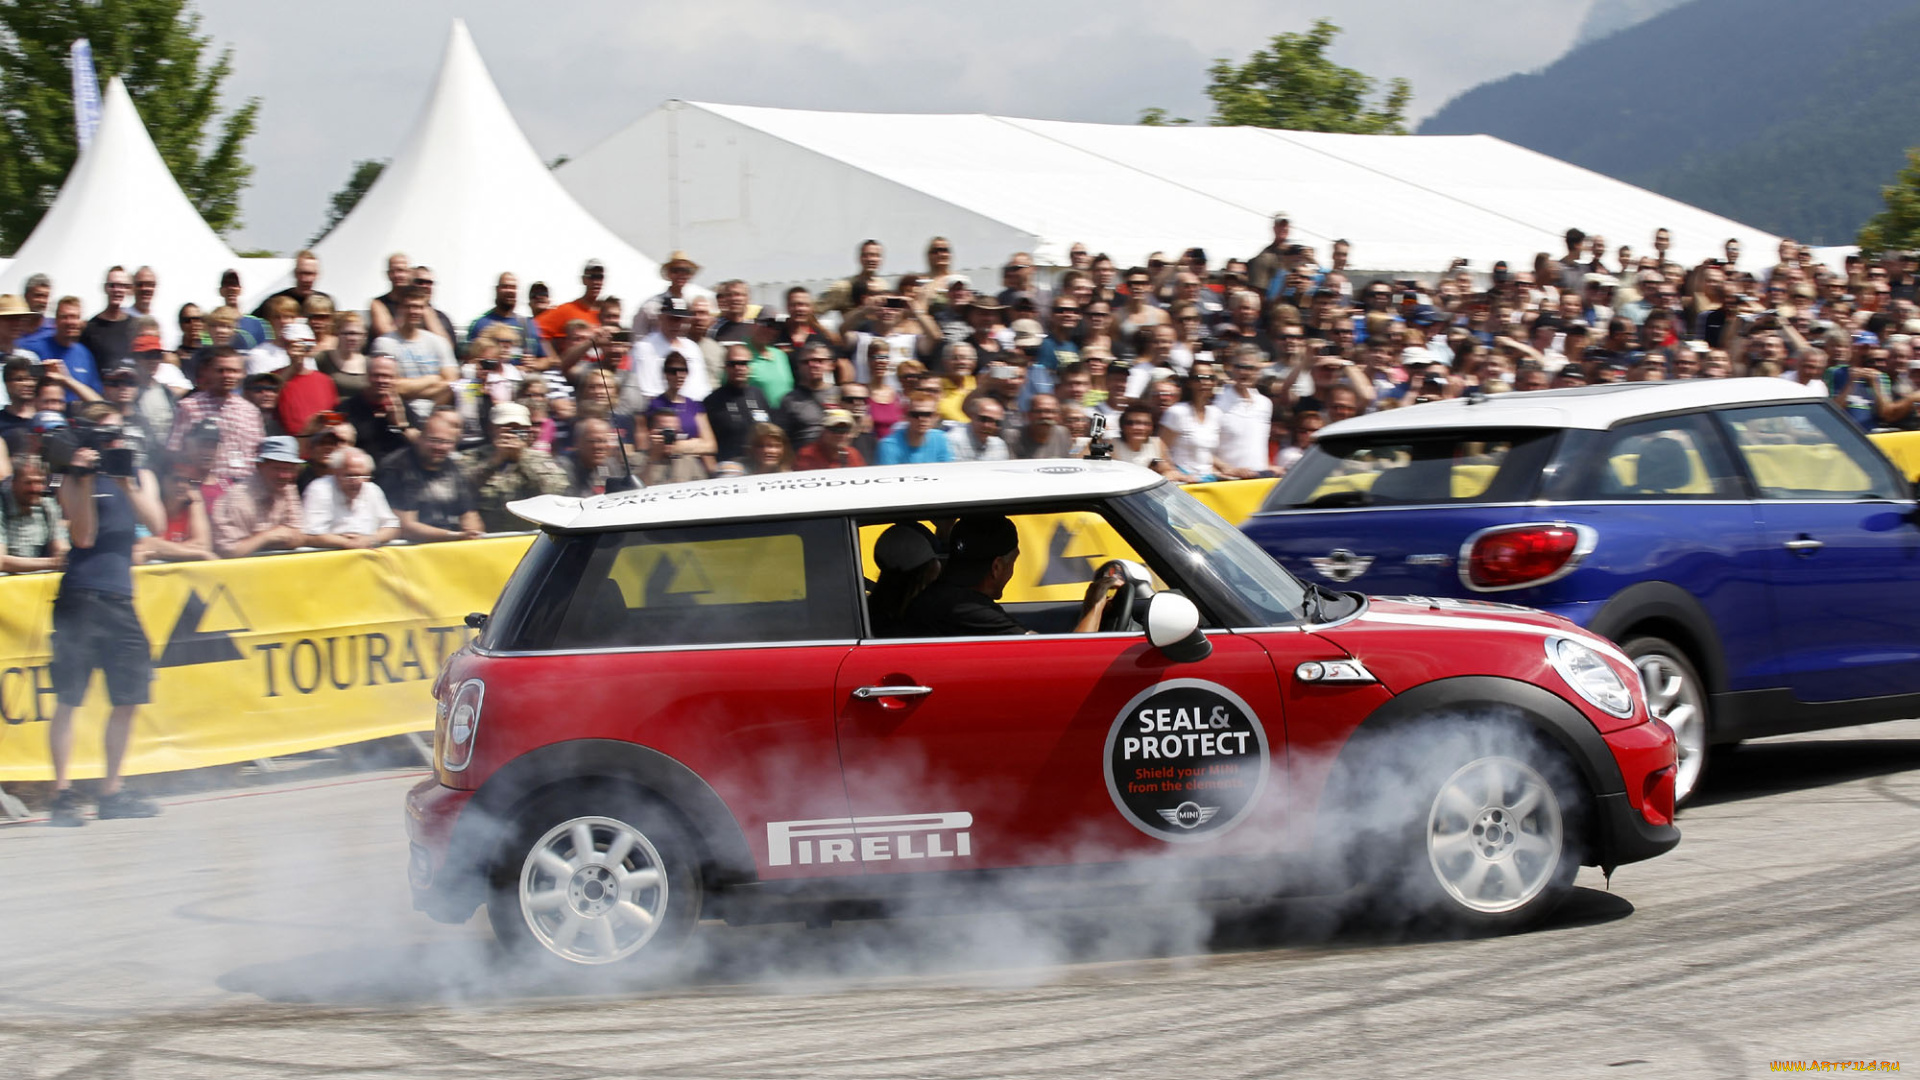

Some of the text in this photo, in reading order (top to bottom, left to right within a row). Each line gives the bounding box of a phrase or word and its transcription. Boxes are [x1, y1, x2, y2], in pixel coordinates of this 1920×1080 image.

[596, 476, 939, 509] CAR CARE PRODUCTS.
[757, 477, 826, 486] MINI
[255, 624, 482, 697] TOURAT
[1123, 731, 1250, 760] PROTECT
[1135, 763, 1239, 780] Shield your MINI
[1128, 782, 1158, 793] from
[1161, 779, 1182, 791] the
[1178, 811, 1199, 820] MINI
[767, 811, 973, 866] PIRELLI
